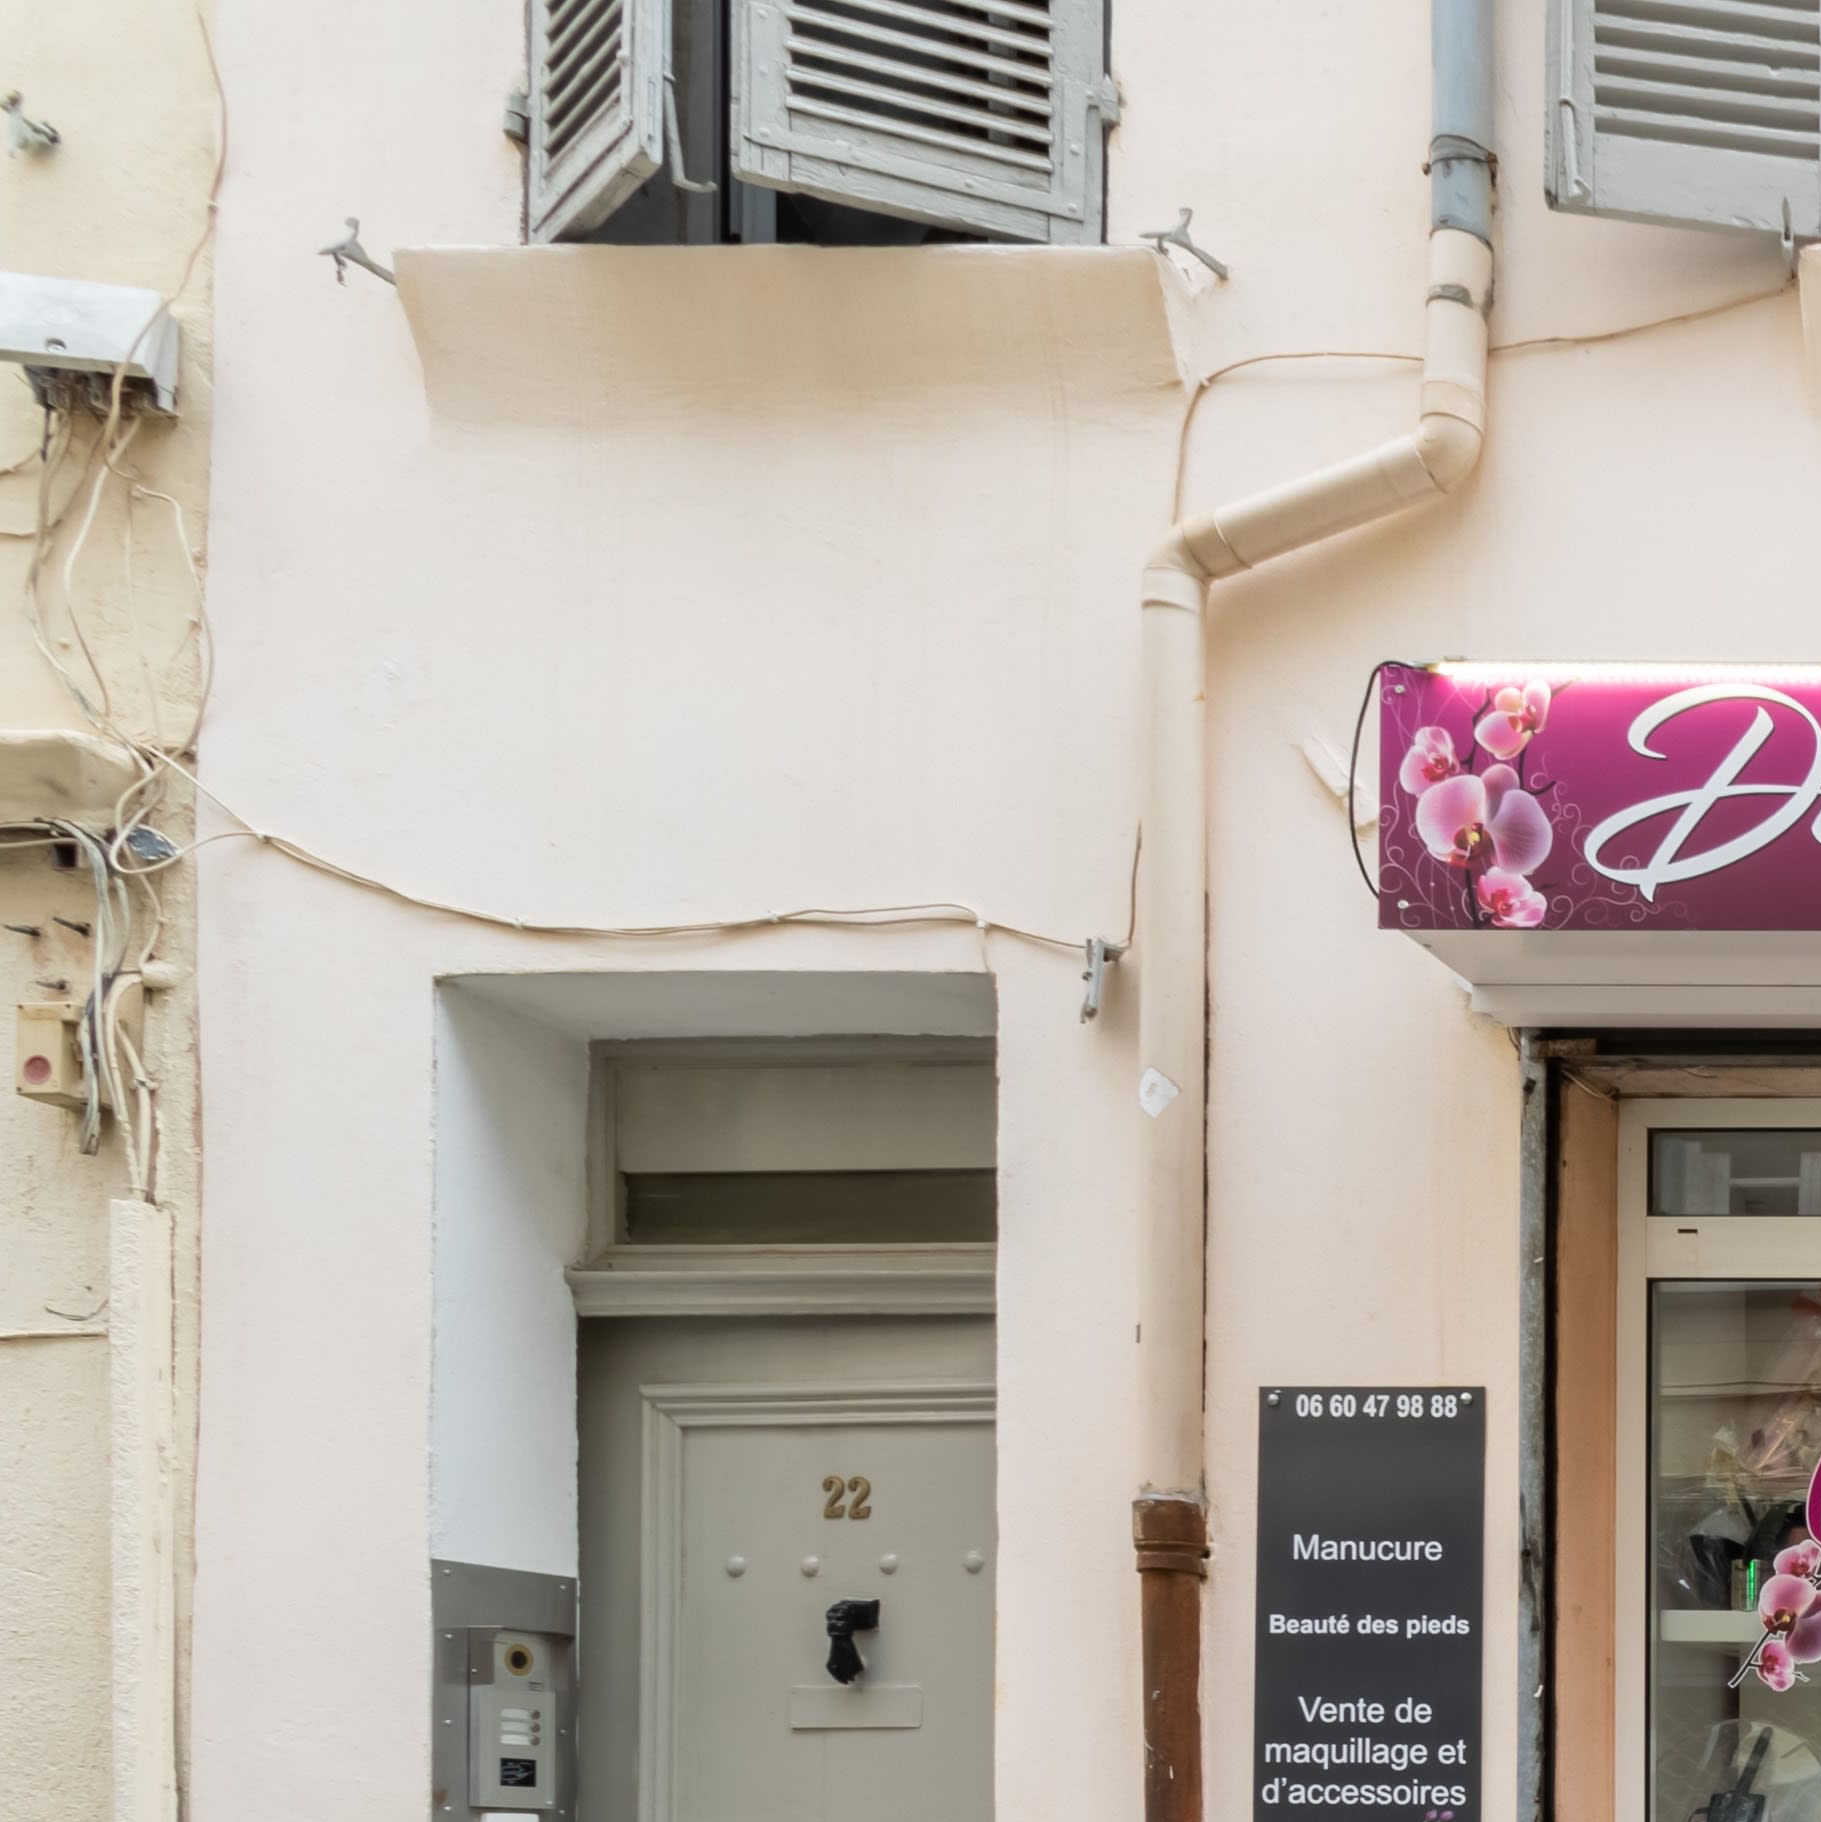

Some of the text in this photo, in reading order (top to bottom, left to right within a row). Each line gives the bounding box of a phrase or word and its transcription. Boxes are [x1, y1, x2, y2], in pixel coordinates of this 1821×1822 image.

[1296, 1394, 1457, 1418] 06 60 47 98 88
[823, 1475, 872, 1519] 22
[1293, 1534, 1443, 1561] Manucure
[1269, 1614, 1470, 1638] Beauté des pieds
[1298, 1697, 1432, 1724] Vente de
[1264, 1738, 1467, 1770] maquillage et
[1262, 1778, 1467, 1806] d'accessoires
